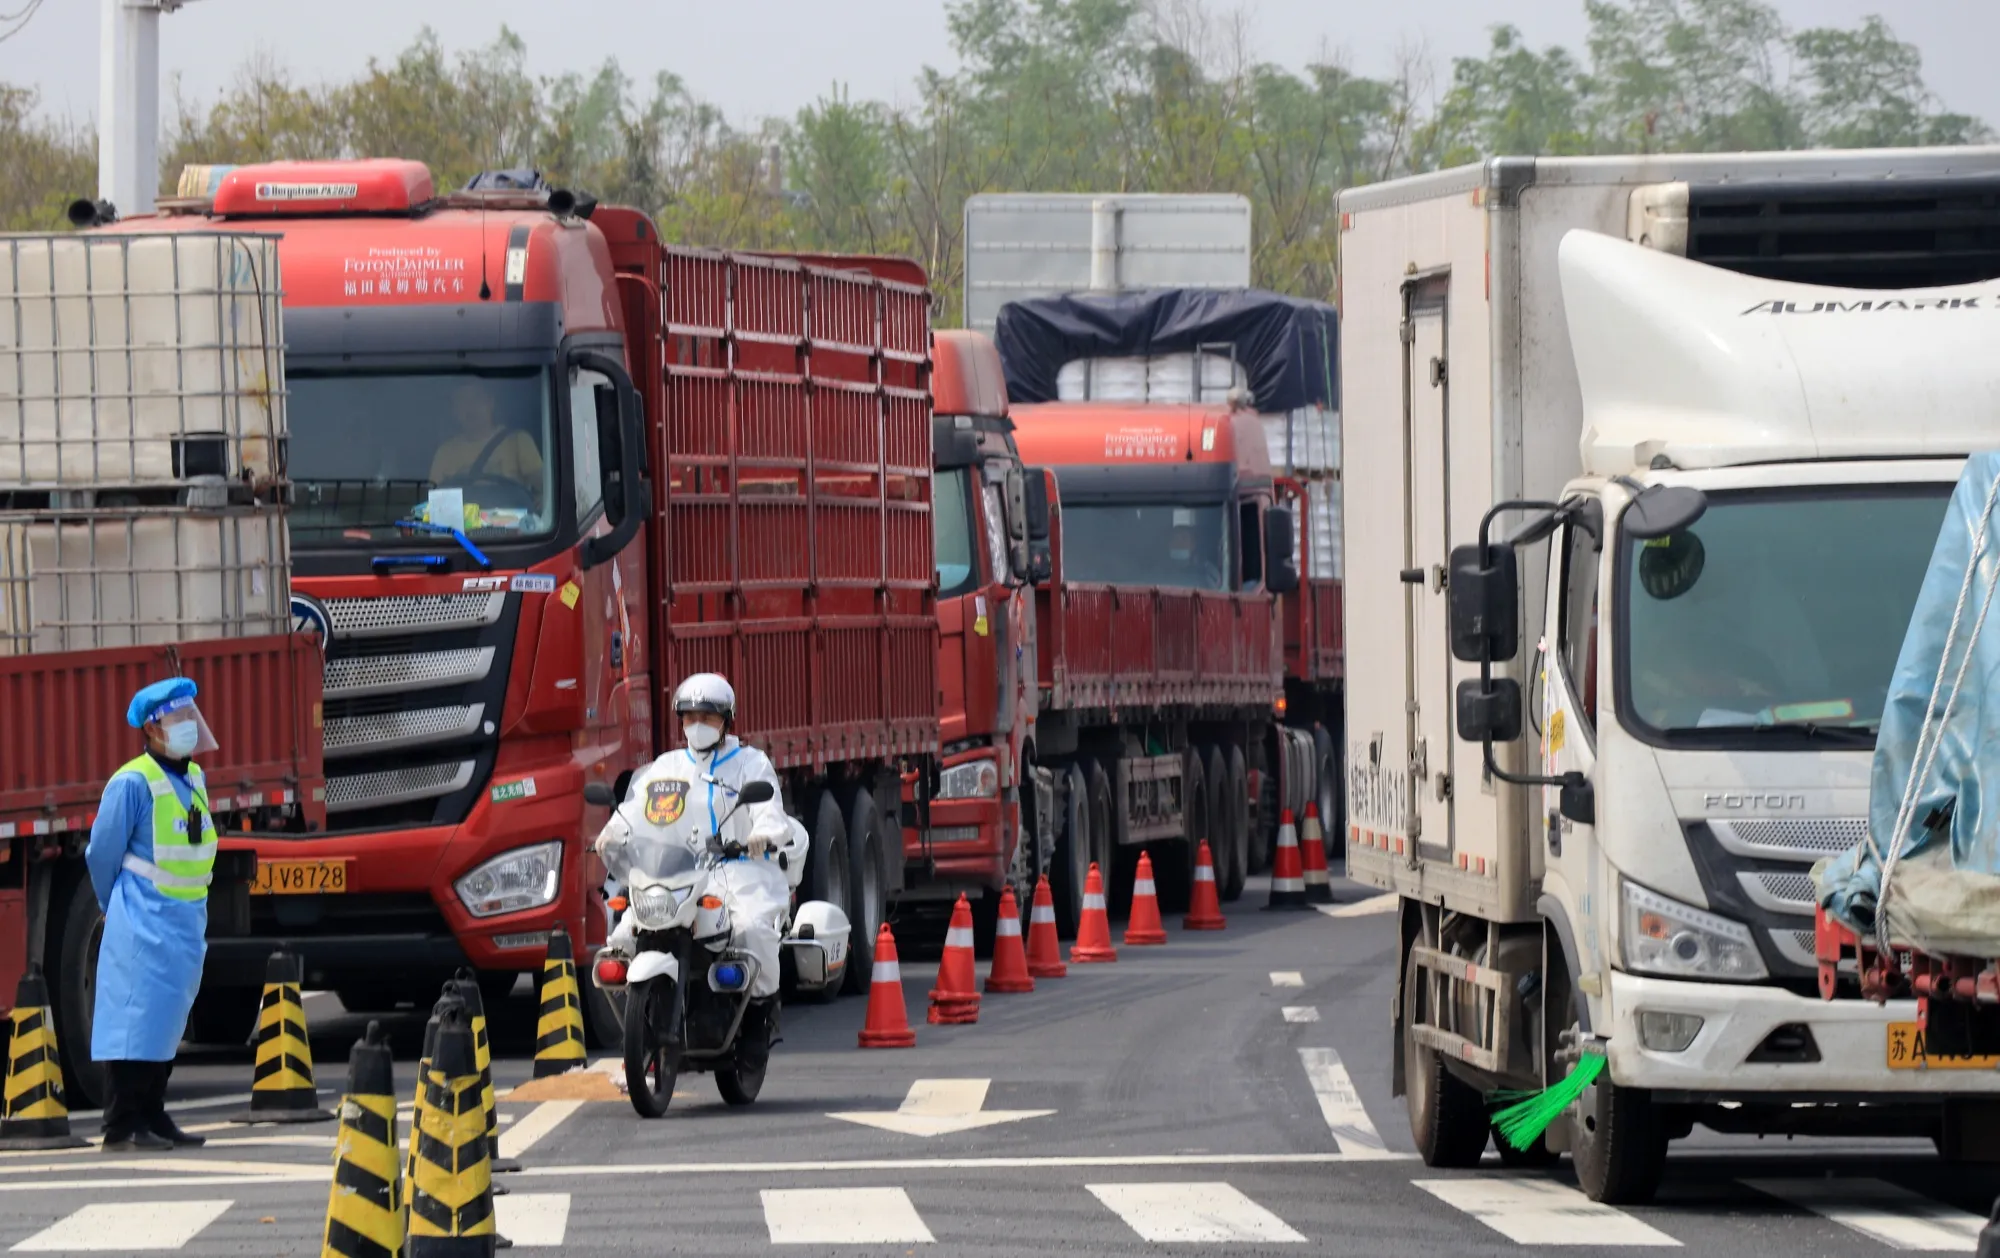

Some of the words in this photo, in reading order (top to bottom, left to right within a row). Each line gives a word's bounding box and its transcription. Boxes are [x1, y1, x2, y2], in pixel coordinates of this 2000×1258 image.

[368, 246, 423, 257] Produced
[427, 246, 441, 258] by
[344, 277, 464, 296] 福田戴姆勒汽车
[1738, 296, 1982, 317] AUMARK
[462, 576, 508, 592] EST
[1703, 794, 1805, 810] FOTON
